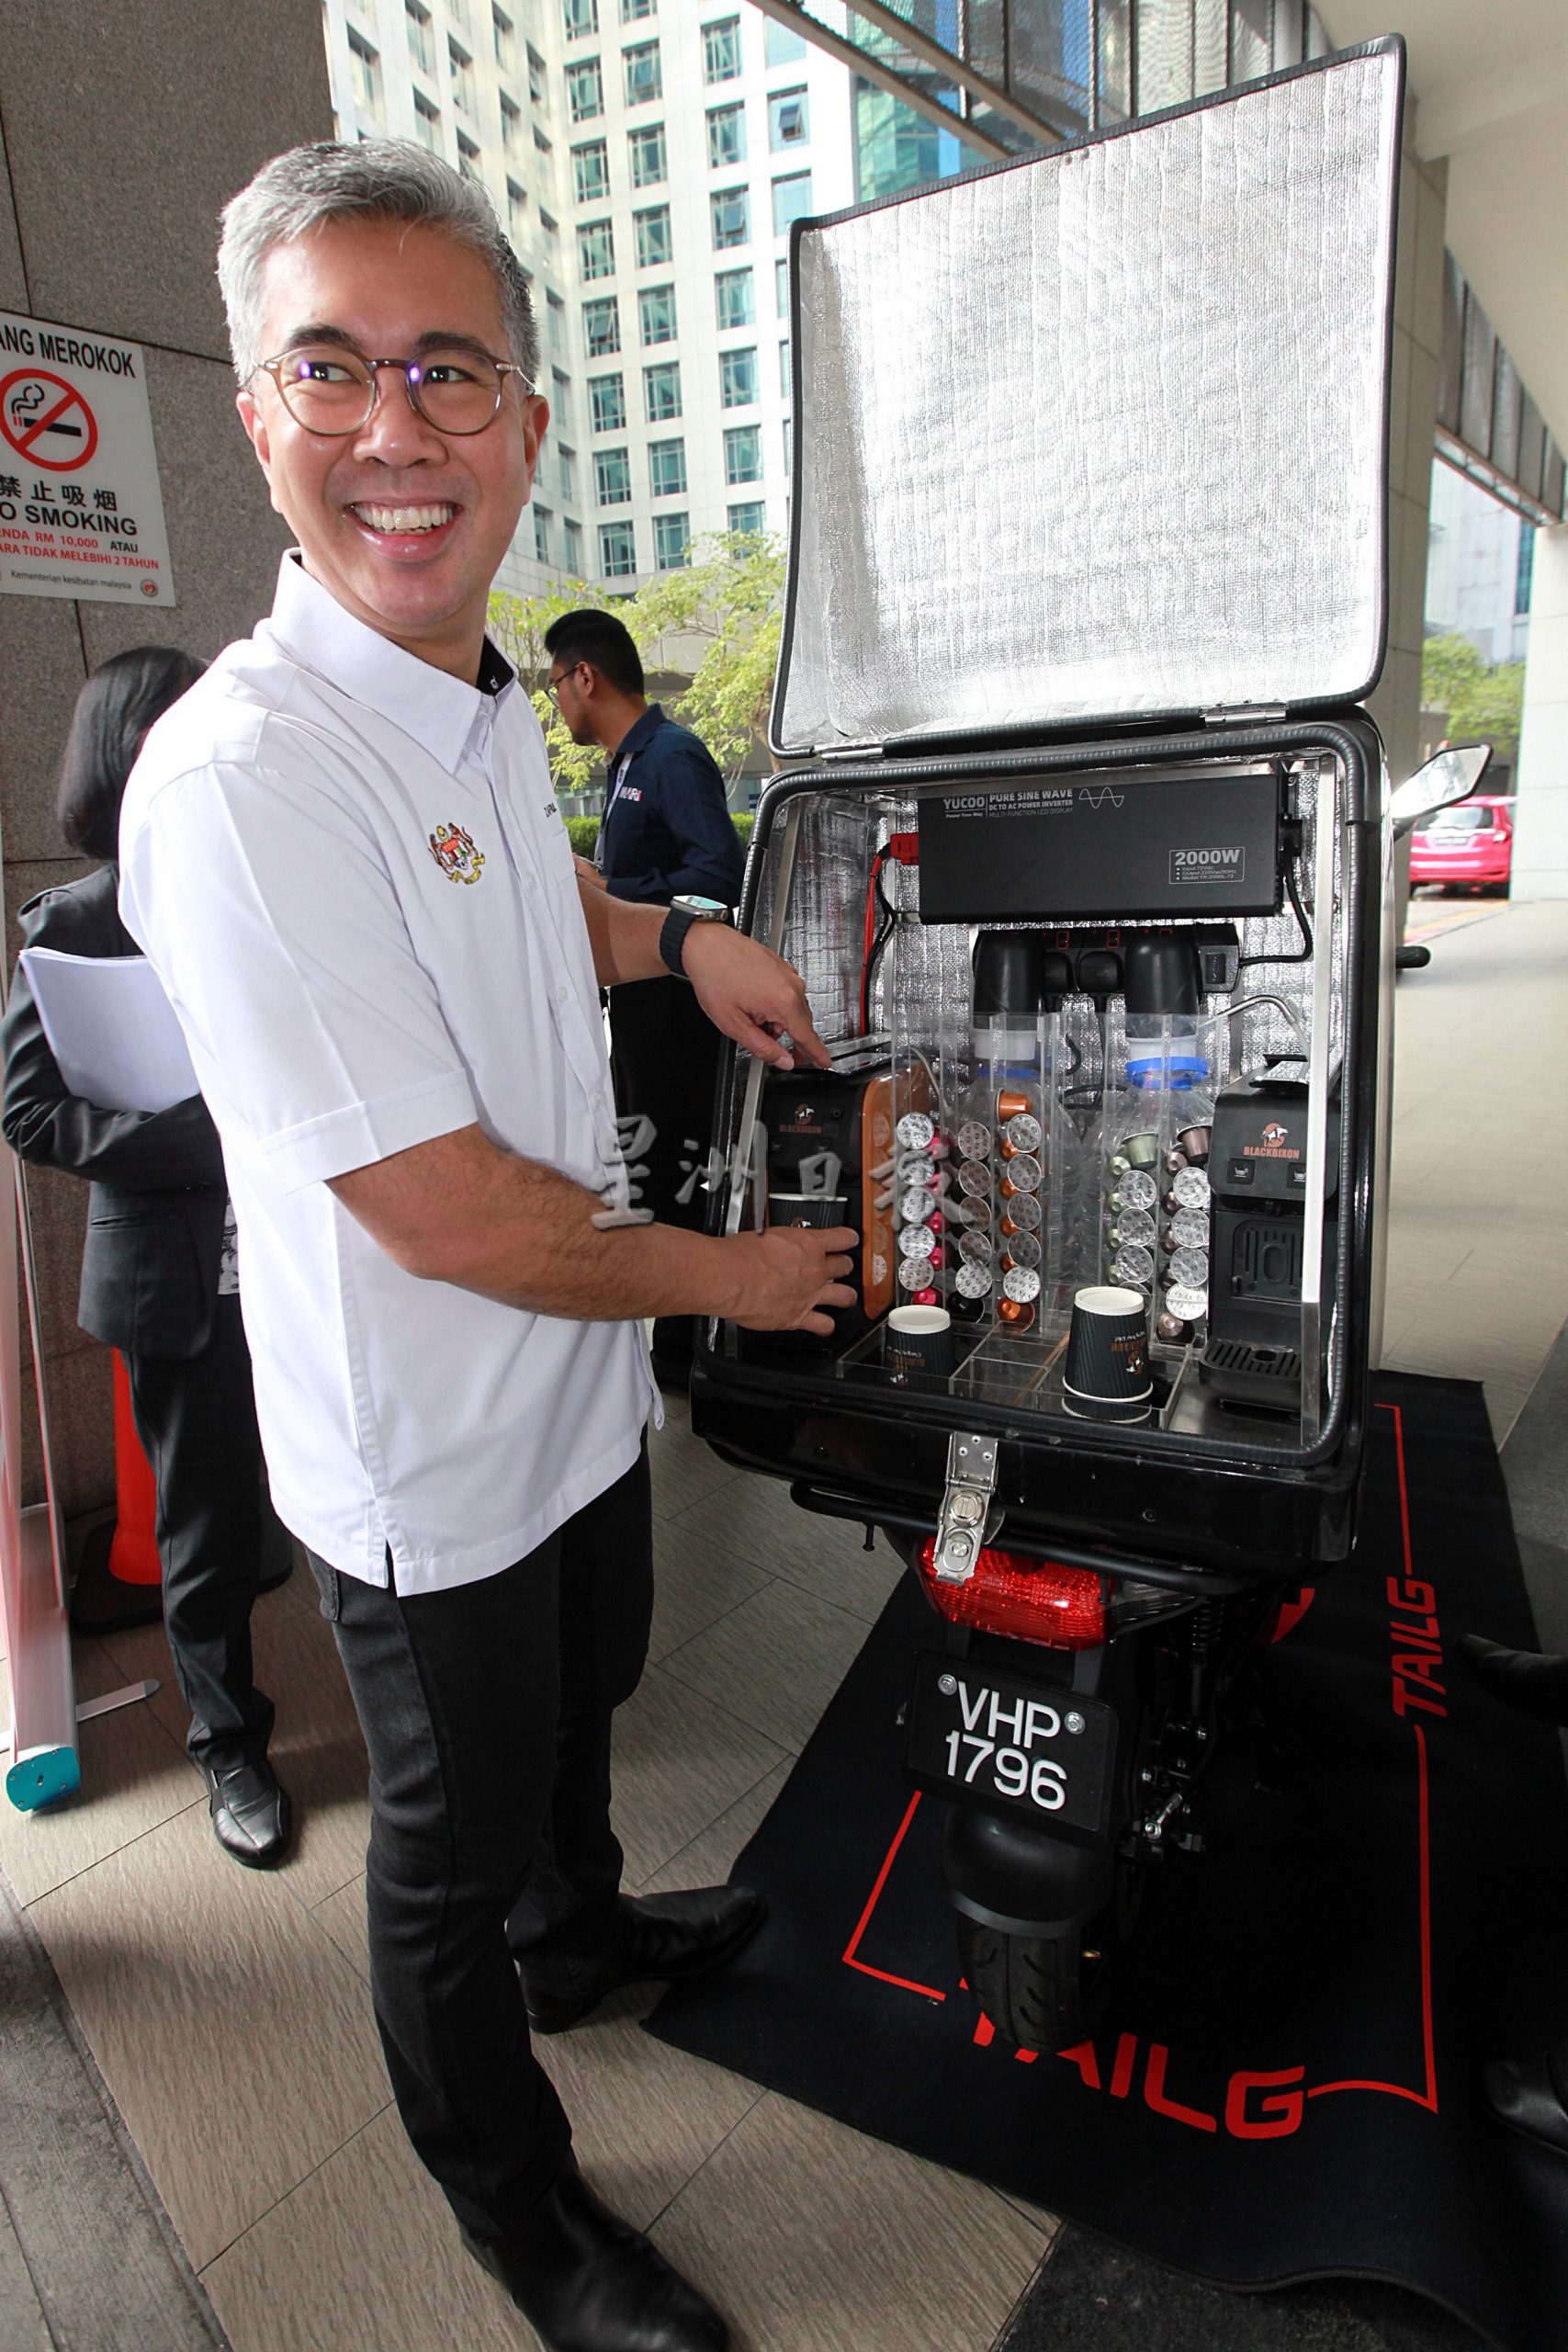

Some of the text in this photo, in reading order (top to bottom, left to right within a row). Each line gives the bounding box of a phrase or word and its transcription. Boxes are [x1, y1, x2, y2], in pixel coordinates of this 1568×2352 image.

[39, 332, 135, 379] MEROKOK
[0, 474, 118, 512] 禁止吸烟
[25, 504, 137, 536] SMOKING
[0, 527, 139, 552] NDA RM 10,000 ATAU
[22, 545, 58, 559] TIDAK
[61, 549, 112, 564] MELEBIHI
[115, 556, 121, 566] 2
[123, 556, 159, 570] TAHUN
[10, 570, 132, 590] Kementerian kesihatan malaysia
[942, 797, 986, 810] YUCOO
[989, 788, 1073, 803] PURE SINE WAVE
[1018, 801, 1041, 809] POWER
[1042, 799, 1073, 808] INVERTER
[1175, 849, 1240, 865] 2000W
[1243, 1146, 1300, 1159] BLACKBIXON
[1386, 1577, 1448, 1717] TAILG
[958, 1680, 1061, 1749] VHP
[945, 1729, 1067, 1810] 1796
